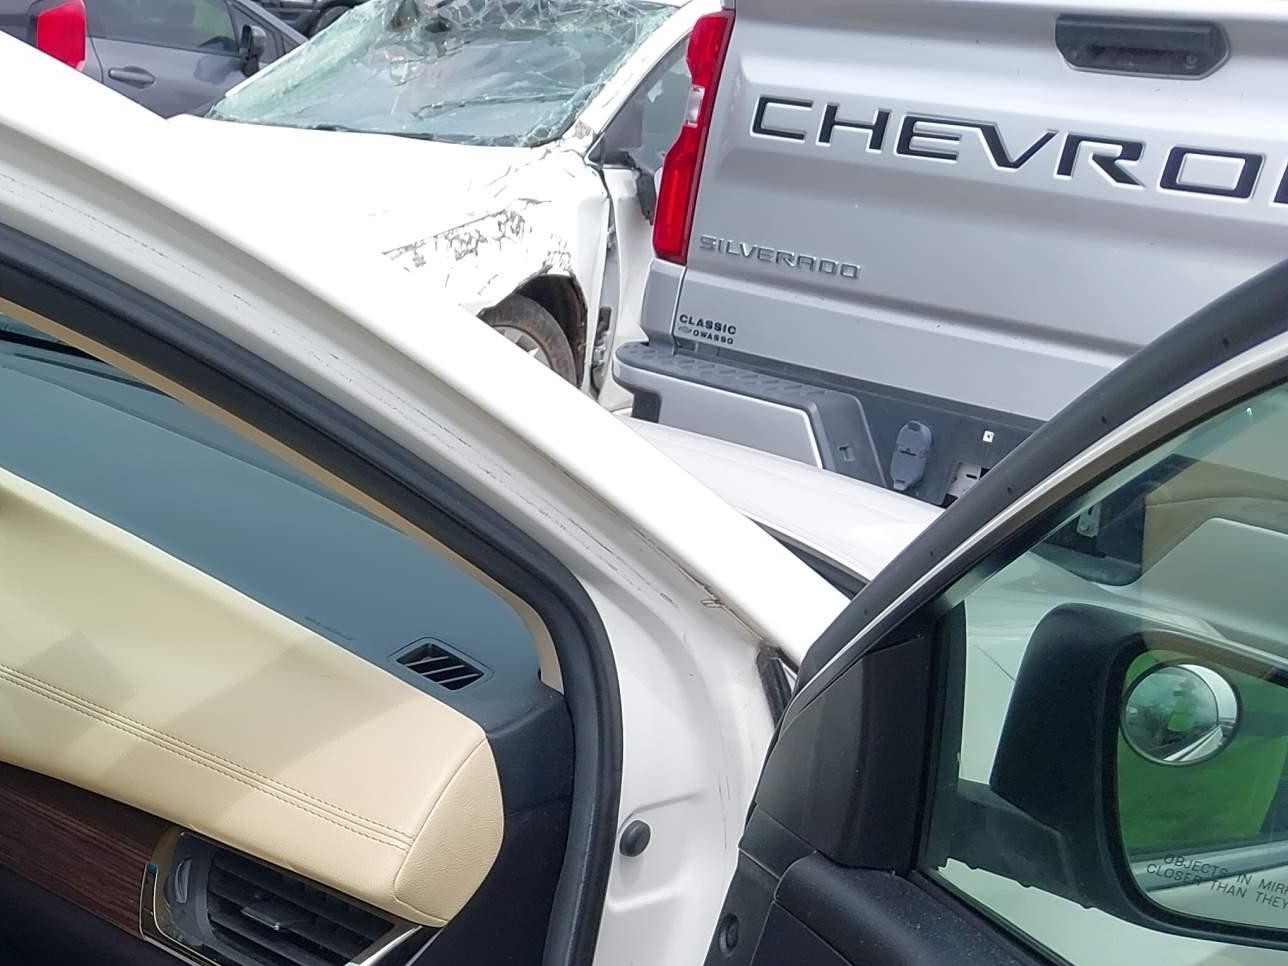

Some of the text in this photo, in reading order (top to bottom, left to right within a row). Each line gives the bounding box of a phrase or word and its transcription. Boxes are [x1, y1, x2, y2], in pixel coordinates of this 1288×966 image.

[751, 96, 1288, 205] CHEVRO
[699, 234, 862, 280] SILVERADO
[679, 314, 737, 335] CLASSIC
[692, 329, 734, 345] OWASSO
[1146, 863, 1201, 886] CLOSER
[1209, 880, 1248, 898] THAN
[1163, 854, 1229, 878] OBJECTS
[1237, 872, 1253, 886] IN
